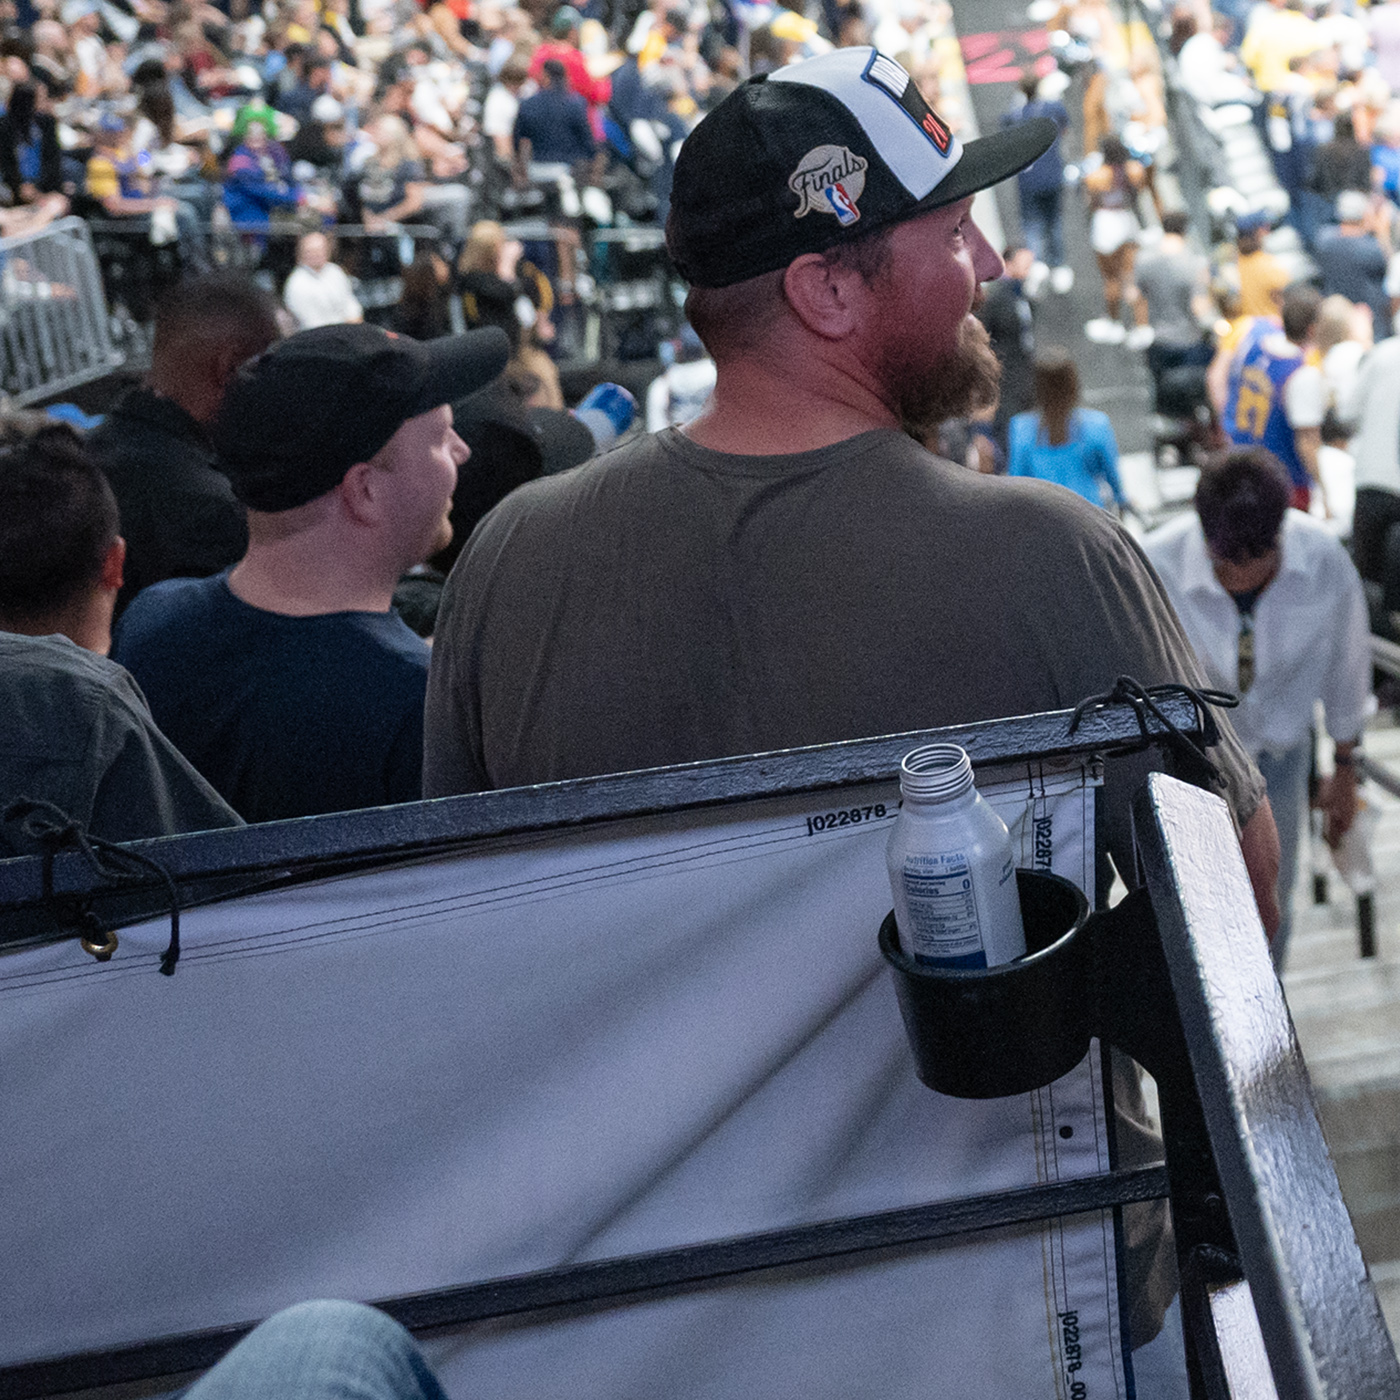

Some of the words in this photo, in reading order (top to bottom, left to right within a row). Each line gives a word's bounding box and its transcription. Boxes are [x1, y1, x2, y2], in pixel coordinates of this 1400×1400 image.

[791, 150, 866, 216] Finals
[1032, 813, 1054, 873] j02287
[962, 878, 971, 890] 0
